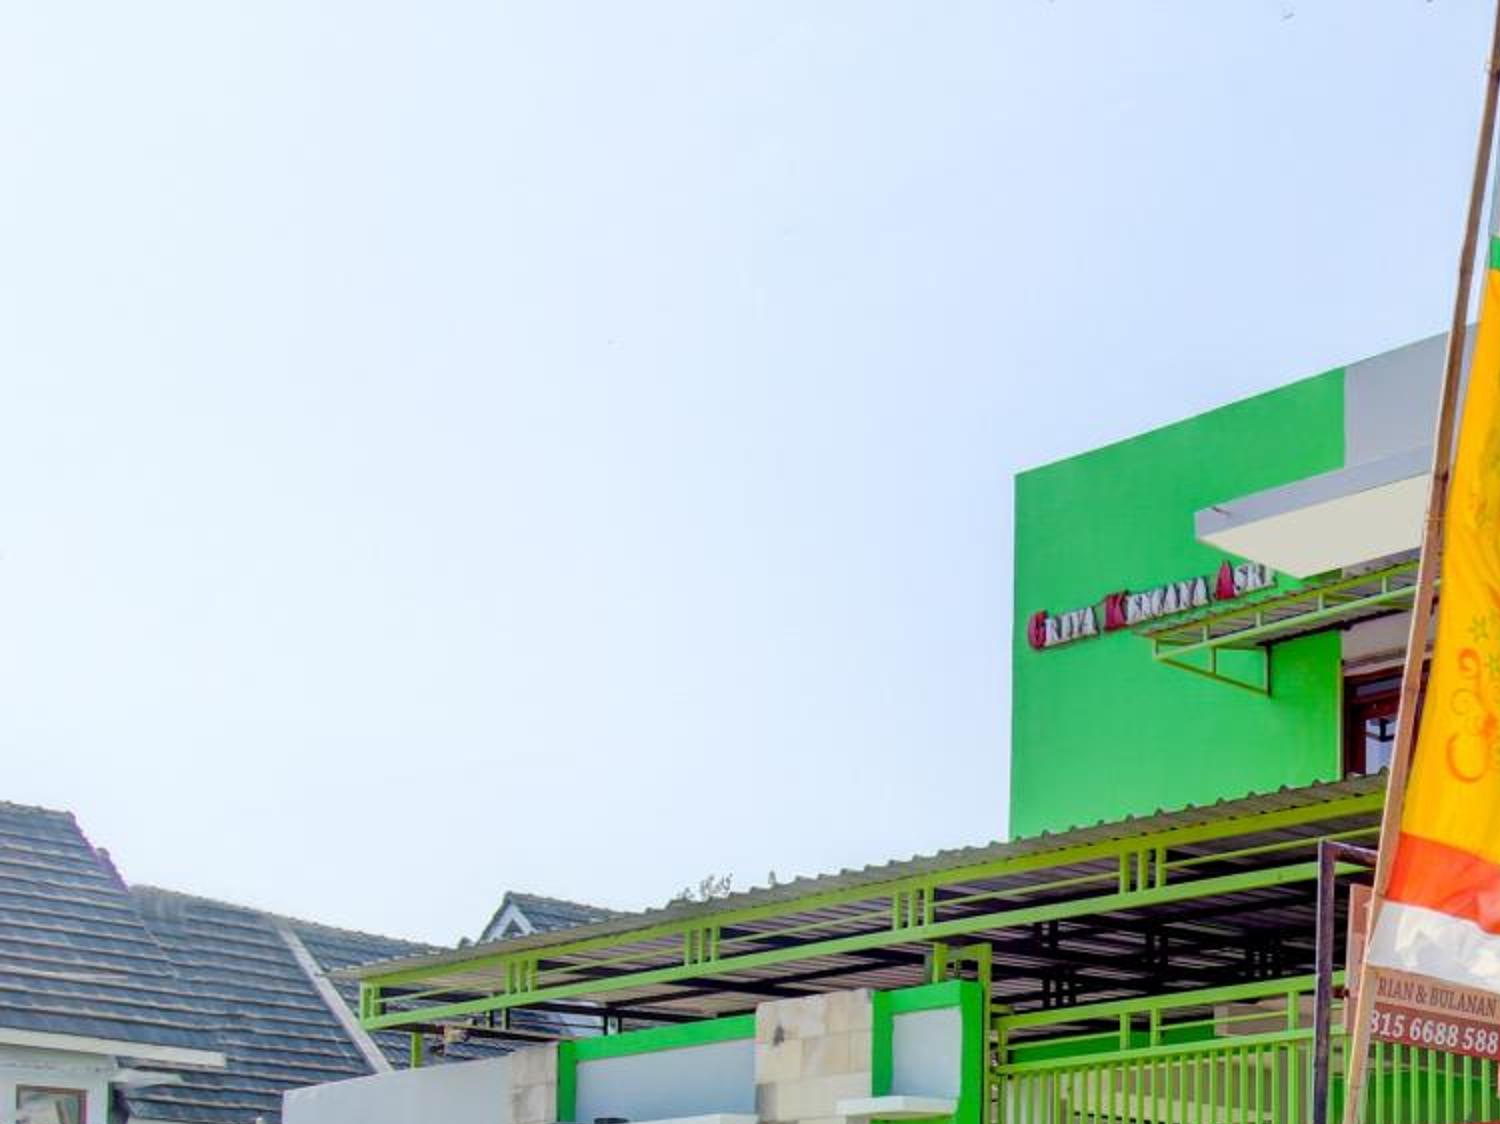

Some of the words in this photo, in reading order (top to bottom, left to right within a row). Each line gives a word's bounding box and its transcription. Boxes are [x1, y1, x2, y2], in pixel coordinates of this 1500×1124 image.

[1028, 607, 1098, 649] GRIYA
[1377, 977, 1415, 1002] RIAN
[1416, 983, 1428, 1004] &
[1430, 987, 1498, 1018] BULANAN
[1371, 1010, 1404, 1037] 815
[1409, 1017, 1458, 1047] 6688
[1462, 1028, 1499, 1054] 588
